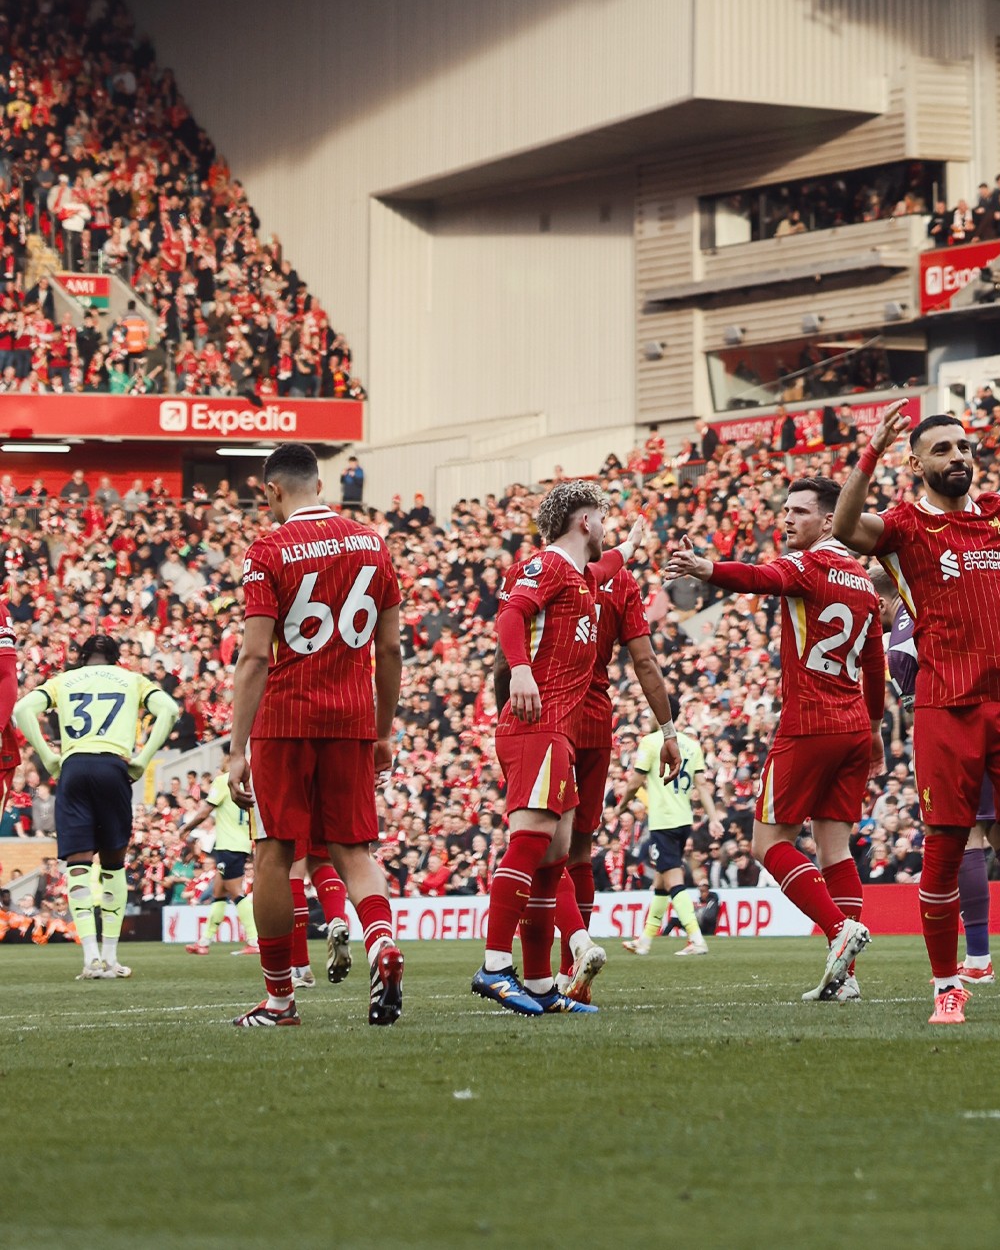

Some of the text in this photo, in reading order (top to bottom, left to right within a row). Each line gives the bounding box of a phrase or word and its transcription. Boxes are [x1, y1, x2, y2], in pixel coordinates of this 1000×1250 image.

[191, 403, 296, 435] Expedia
[281, 535, 381, 564] ALEXANDER-ARNOLD
[283, 566, 378, 655] 66
[64, 692, 125, 739] 37
[716, 900, 772, 937] APP
